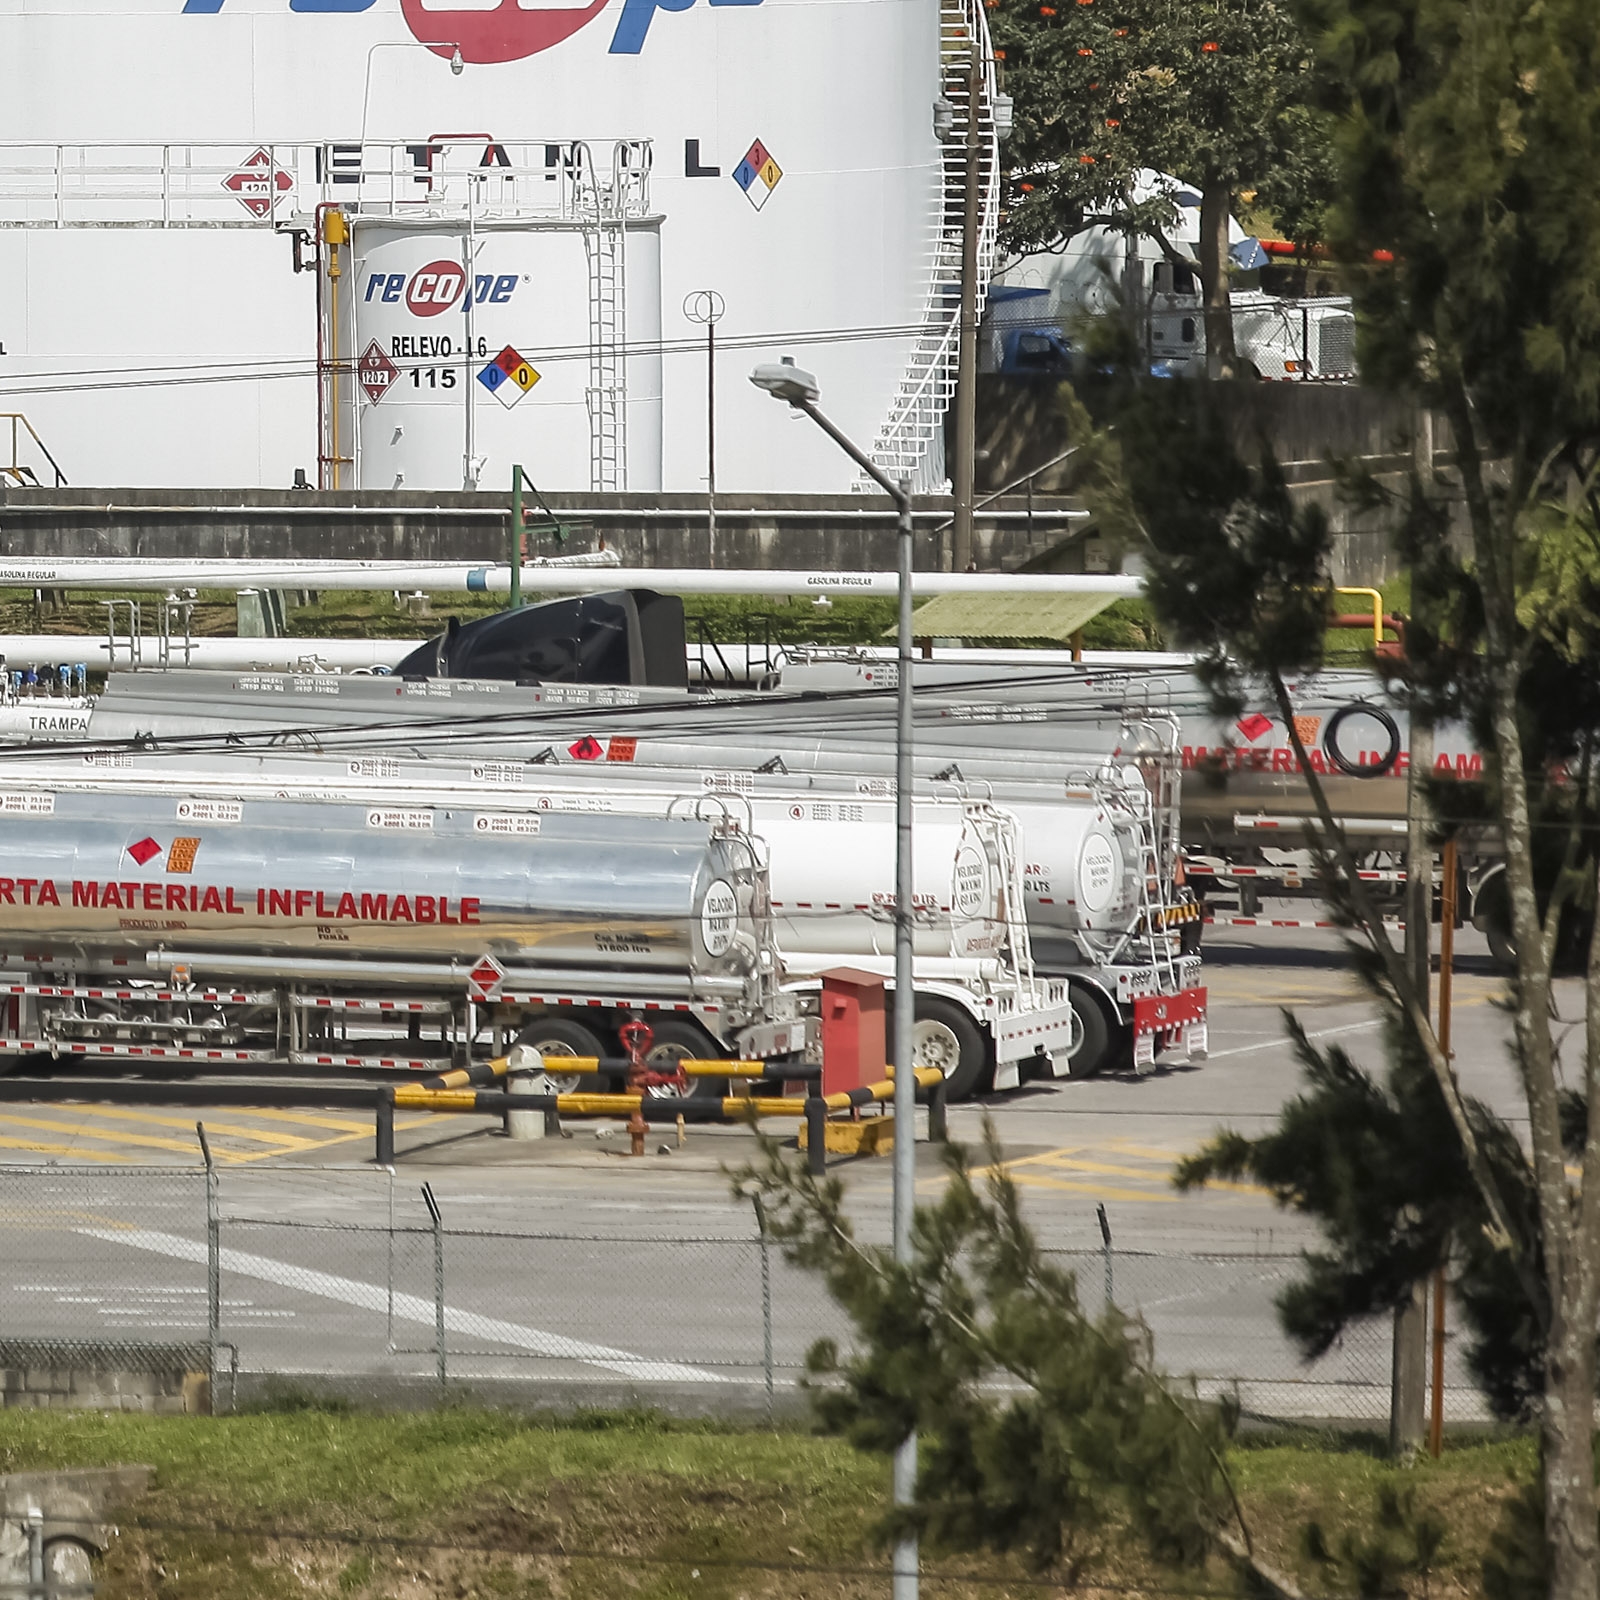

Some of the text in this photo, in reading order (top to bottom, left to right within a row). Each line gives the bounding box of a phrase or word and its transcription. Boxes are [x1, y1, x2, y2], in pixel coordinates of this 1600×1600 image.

[365, 274, 518, 312] recope
[392, 336, 451, 357] RELEVO
[363, 371, 386, 384] 1202
[410, 368, 456, 388] 115
[490, 368, 527, 385] 0 0
[27, 571, 57, 579] REGULAR
[807, 577, 840, 585] GASOLINA
[29, 716, 88, 732] TRAMPA
[1034, 881, 1050, 893] LTS
[72, 881, 243, 914] MATERIAL
[257, 887, 481, 925] INFLAMABLE
